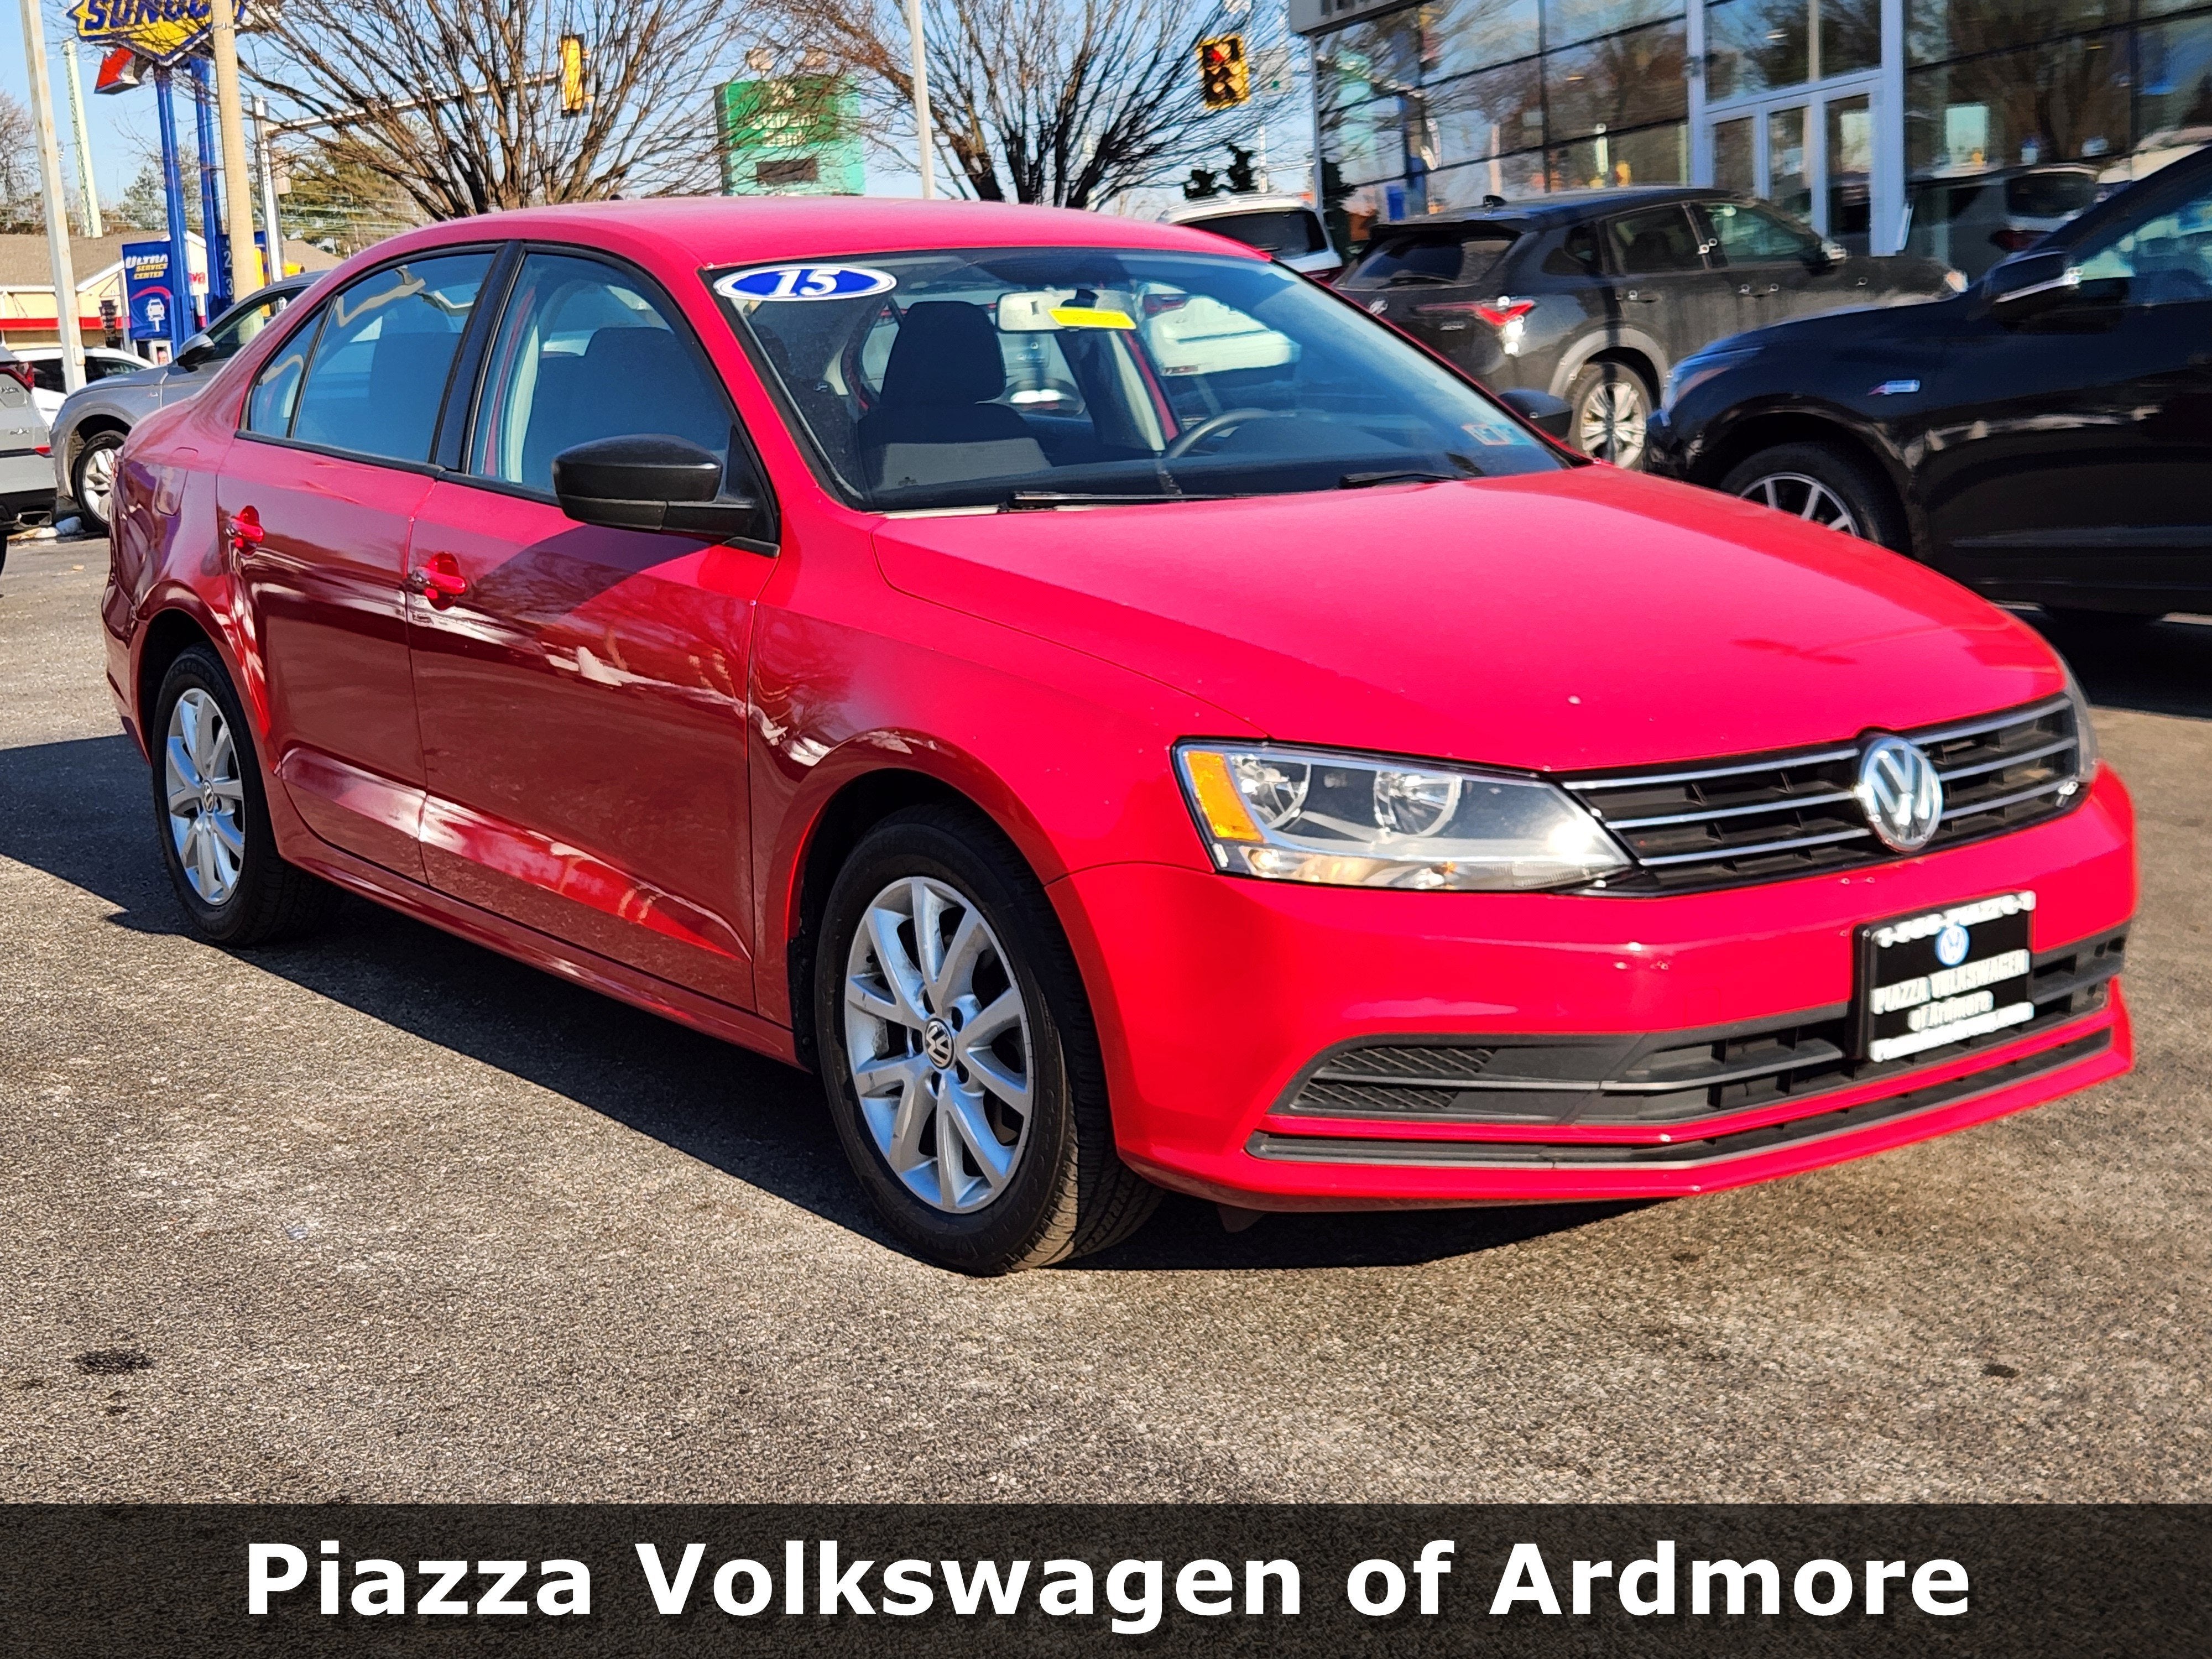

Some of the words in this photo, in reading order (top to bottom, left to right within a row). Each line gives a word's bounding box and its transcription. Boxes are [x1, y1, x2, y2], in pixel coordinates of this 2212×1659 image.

[126, 253, 168, 269] ULTRA
[136, 263, 168, 272] SERVICE
[134, 270, 164, 280] CENTER
[769, 269, 842, 298] 15
[1872, 978, 1930, 1014] PIAZZA
